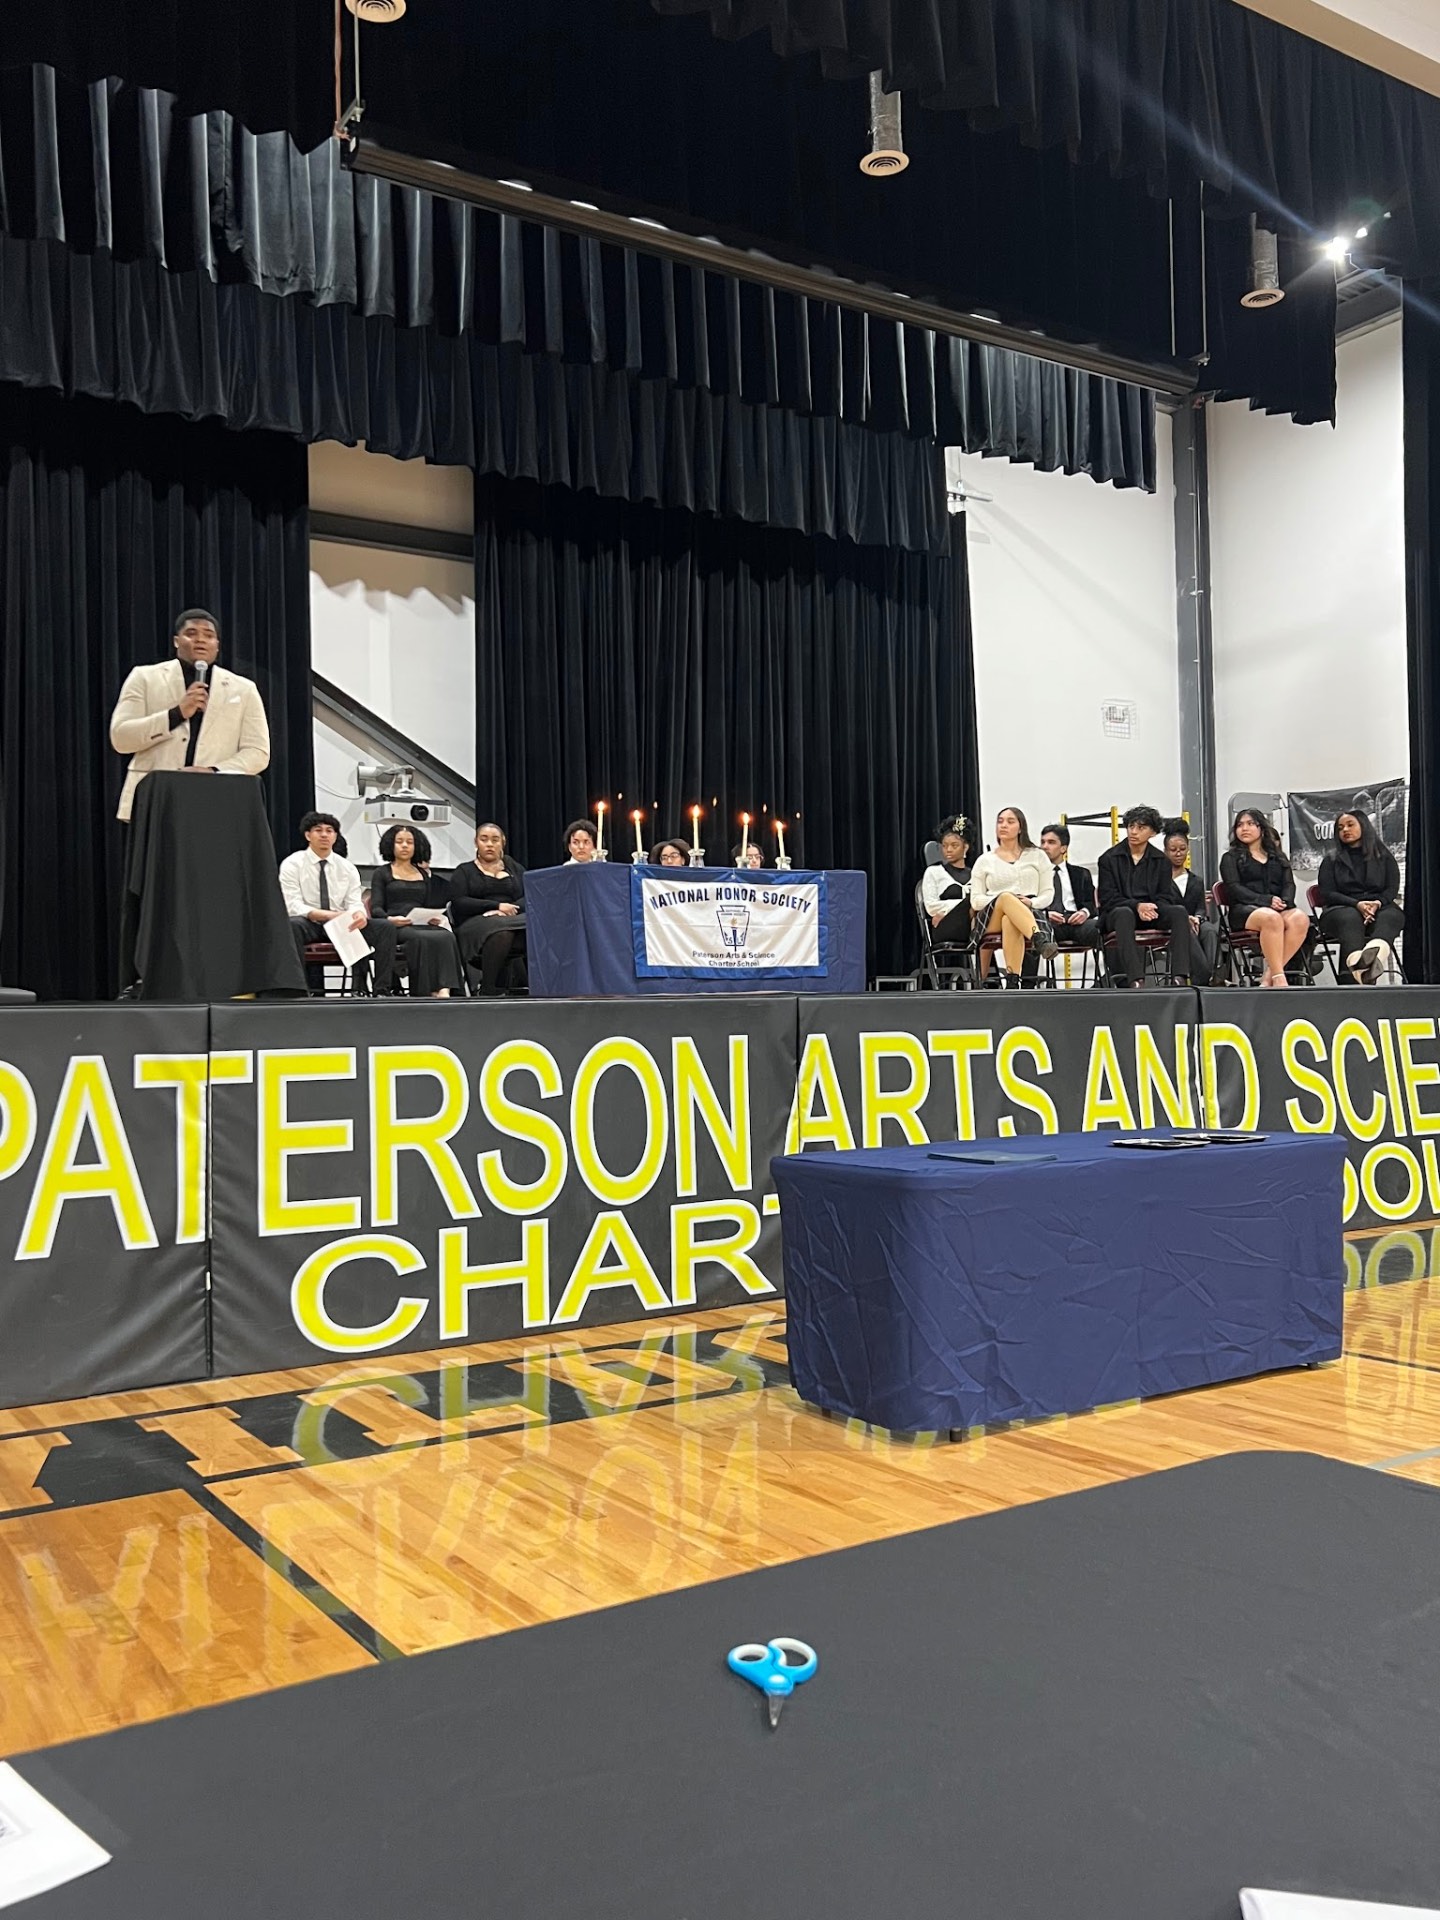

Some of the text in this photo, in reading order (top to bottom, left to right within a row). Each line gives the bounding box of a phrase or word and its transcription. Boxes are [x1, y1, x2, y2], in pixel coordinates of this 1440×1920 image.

[649, 887, 812, 913] NATIONAL HONOR SOCIETY
[692, 950, 724, 959] Paterson
[725, 951, 740, 959] Arts
[748, 951, 775, 959] Science
[784, 1025, 1059, 1156] ARTS
[1082, 1022, 1260, 1132] AND
[1281, 1017, 1440, 1142] SCIE
[291, 1198, 781, 1354] CHAR
